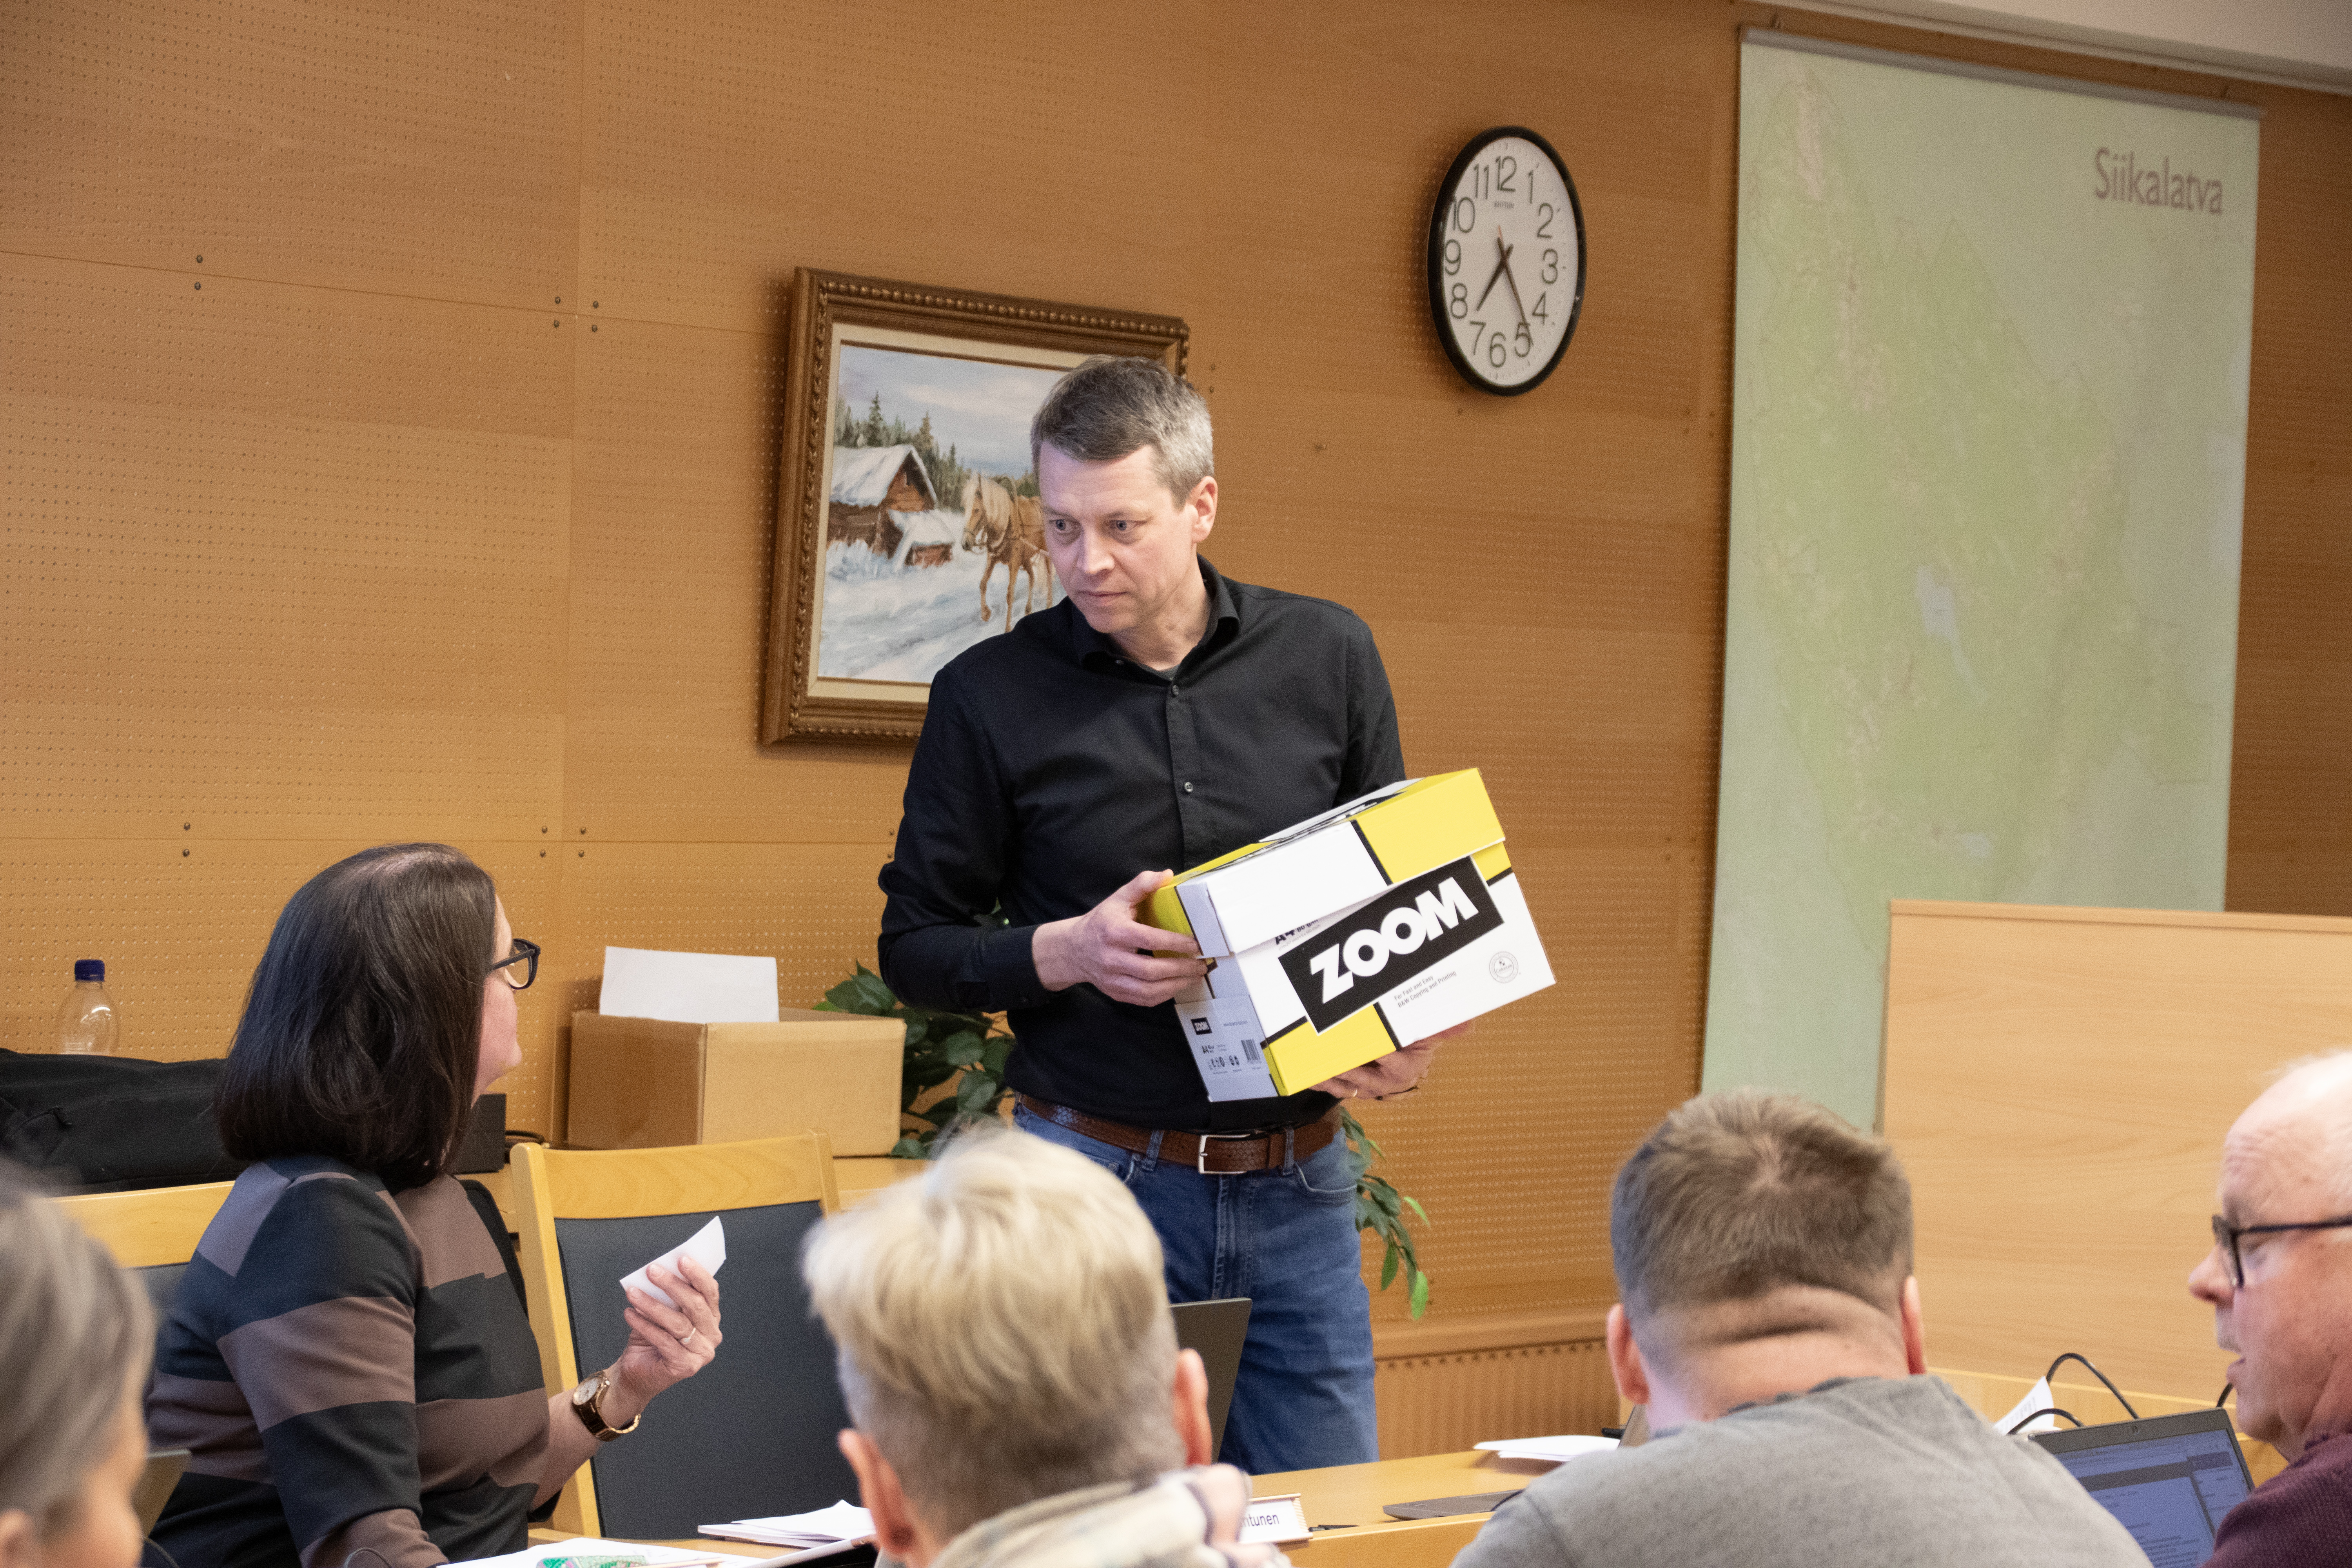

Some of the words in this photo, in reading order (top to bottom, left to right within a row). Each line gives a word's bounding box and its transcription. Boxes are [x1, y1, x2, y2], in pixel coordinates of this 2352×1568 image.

[1474, 164, 1489, 200] 11
[1495, 156, 1516, 192] 12
[1528, 169, 1534, 204] 1
[2094, 147, 2223, 214] Siikalatva
[1451, 196, 1475, 233] 10
[1537, 203, 1553, 238] 2
[1445, 239, 1461, 275] 9
[1542, 249, 1558, 284] 3
[1450, 283, 1468, 319] 8
[1532, 291, 1548, 325] 4
[1470, 321, 1486, 355] 7
[1490, 332, 1506, 367] 6
[1514, 323, 1530, 357] 5
[1310, 877, 1478, 1004] ZOOM
[1397, 998, 1410, 1008] B&W
[1410, 987, 1429, 1000] Copying
[1429, 982, 1438, 990] and
[1438, 971, 1457, 984] Printing
[1403, 987, 1413, 996] Fast
[1414, 982, 1422, 990] and
[1422, 975, 1434, 984] Easy
